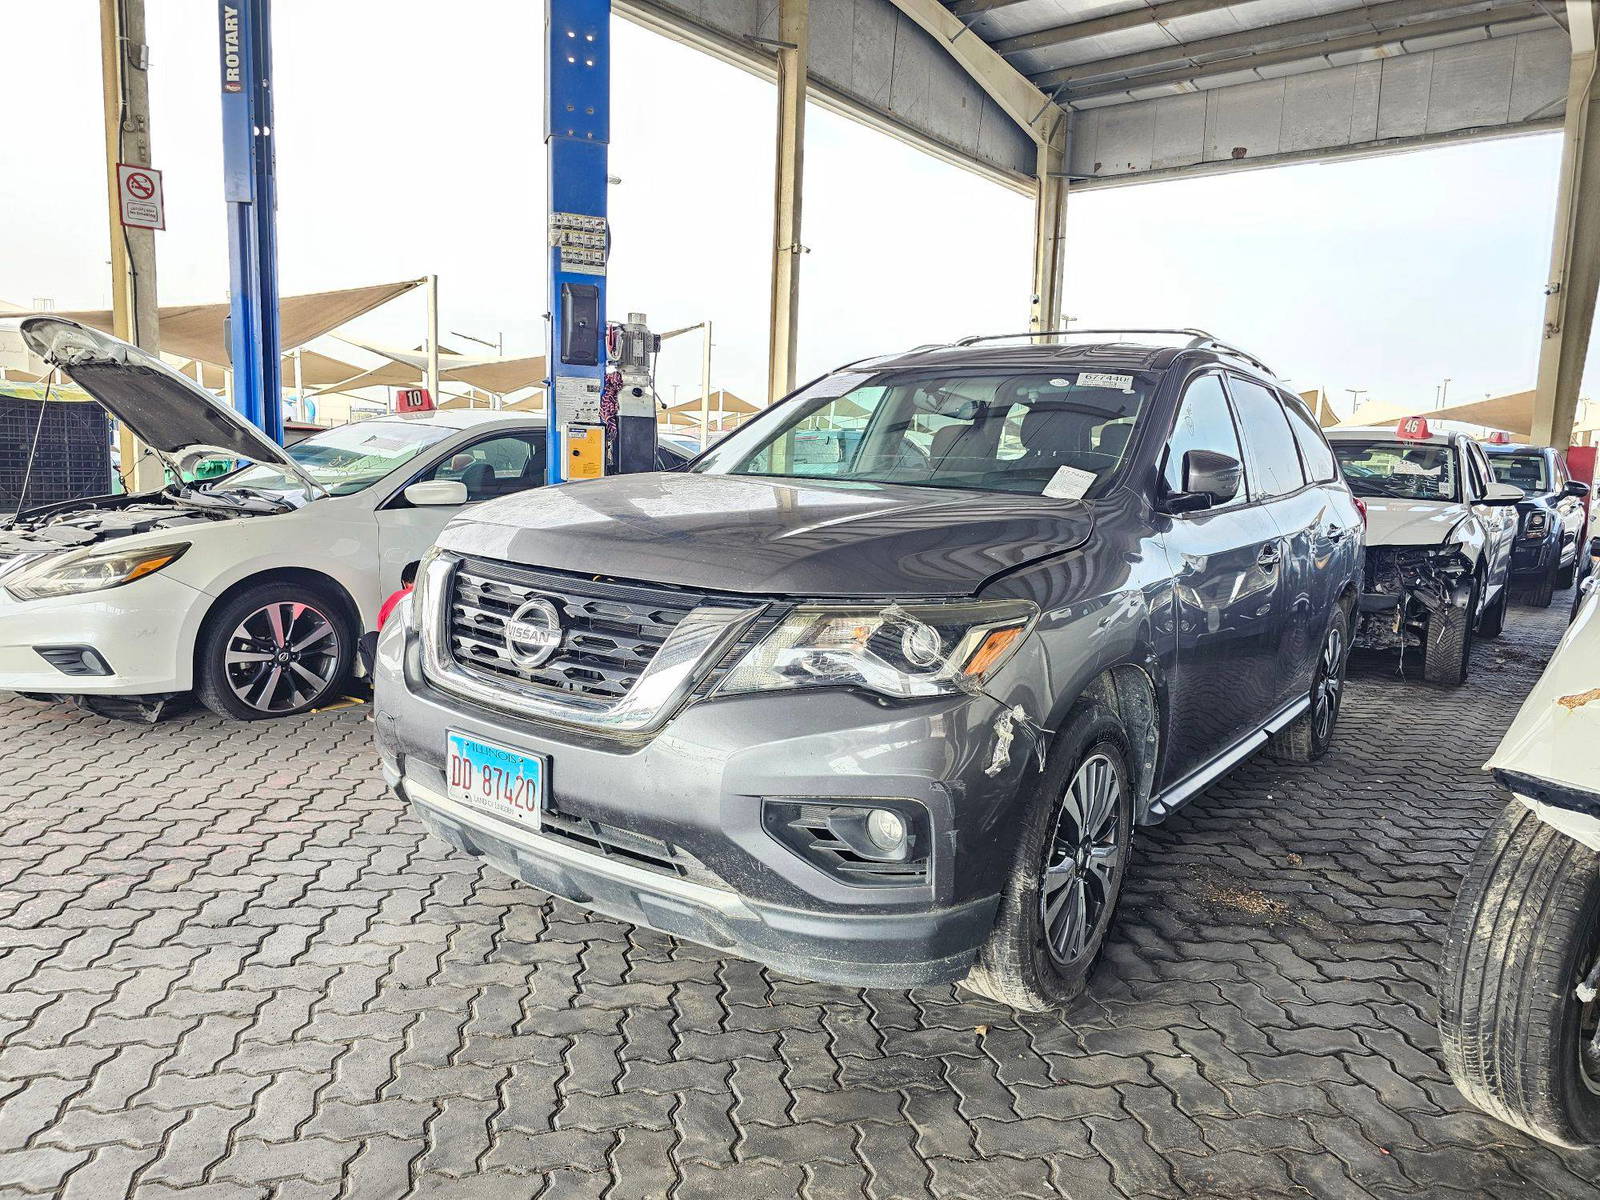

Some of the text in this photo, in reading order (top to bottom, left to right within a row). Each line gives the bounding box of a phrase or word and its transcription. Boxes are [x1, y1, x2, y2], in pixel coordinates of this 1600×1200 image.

[225, 5, 240, 81] ROTARY
[407, 390, 422, 407] 10
[1404, 420, 1420, 433] 46
[507, 621, 551, 643] NISSAN
[471, 743, 517, 764] ILLINOIS
[452, 754, 536, 812] DD 87420
